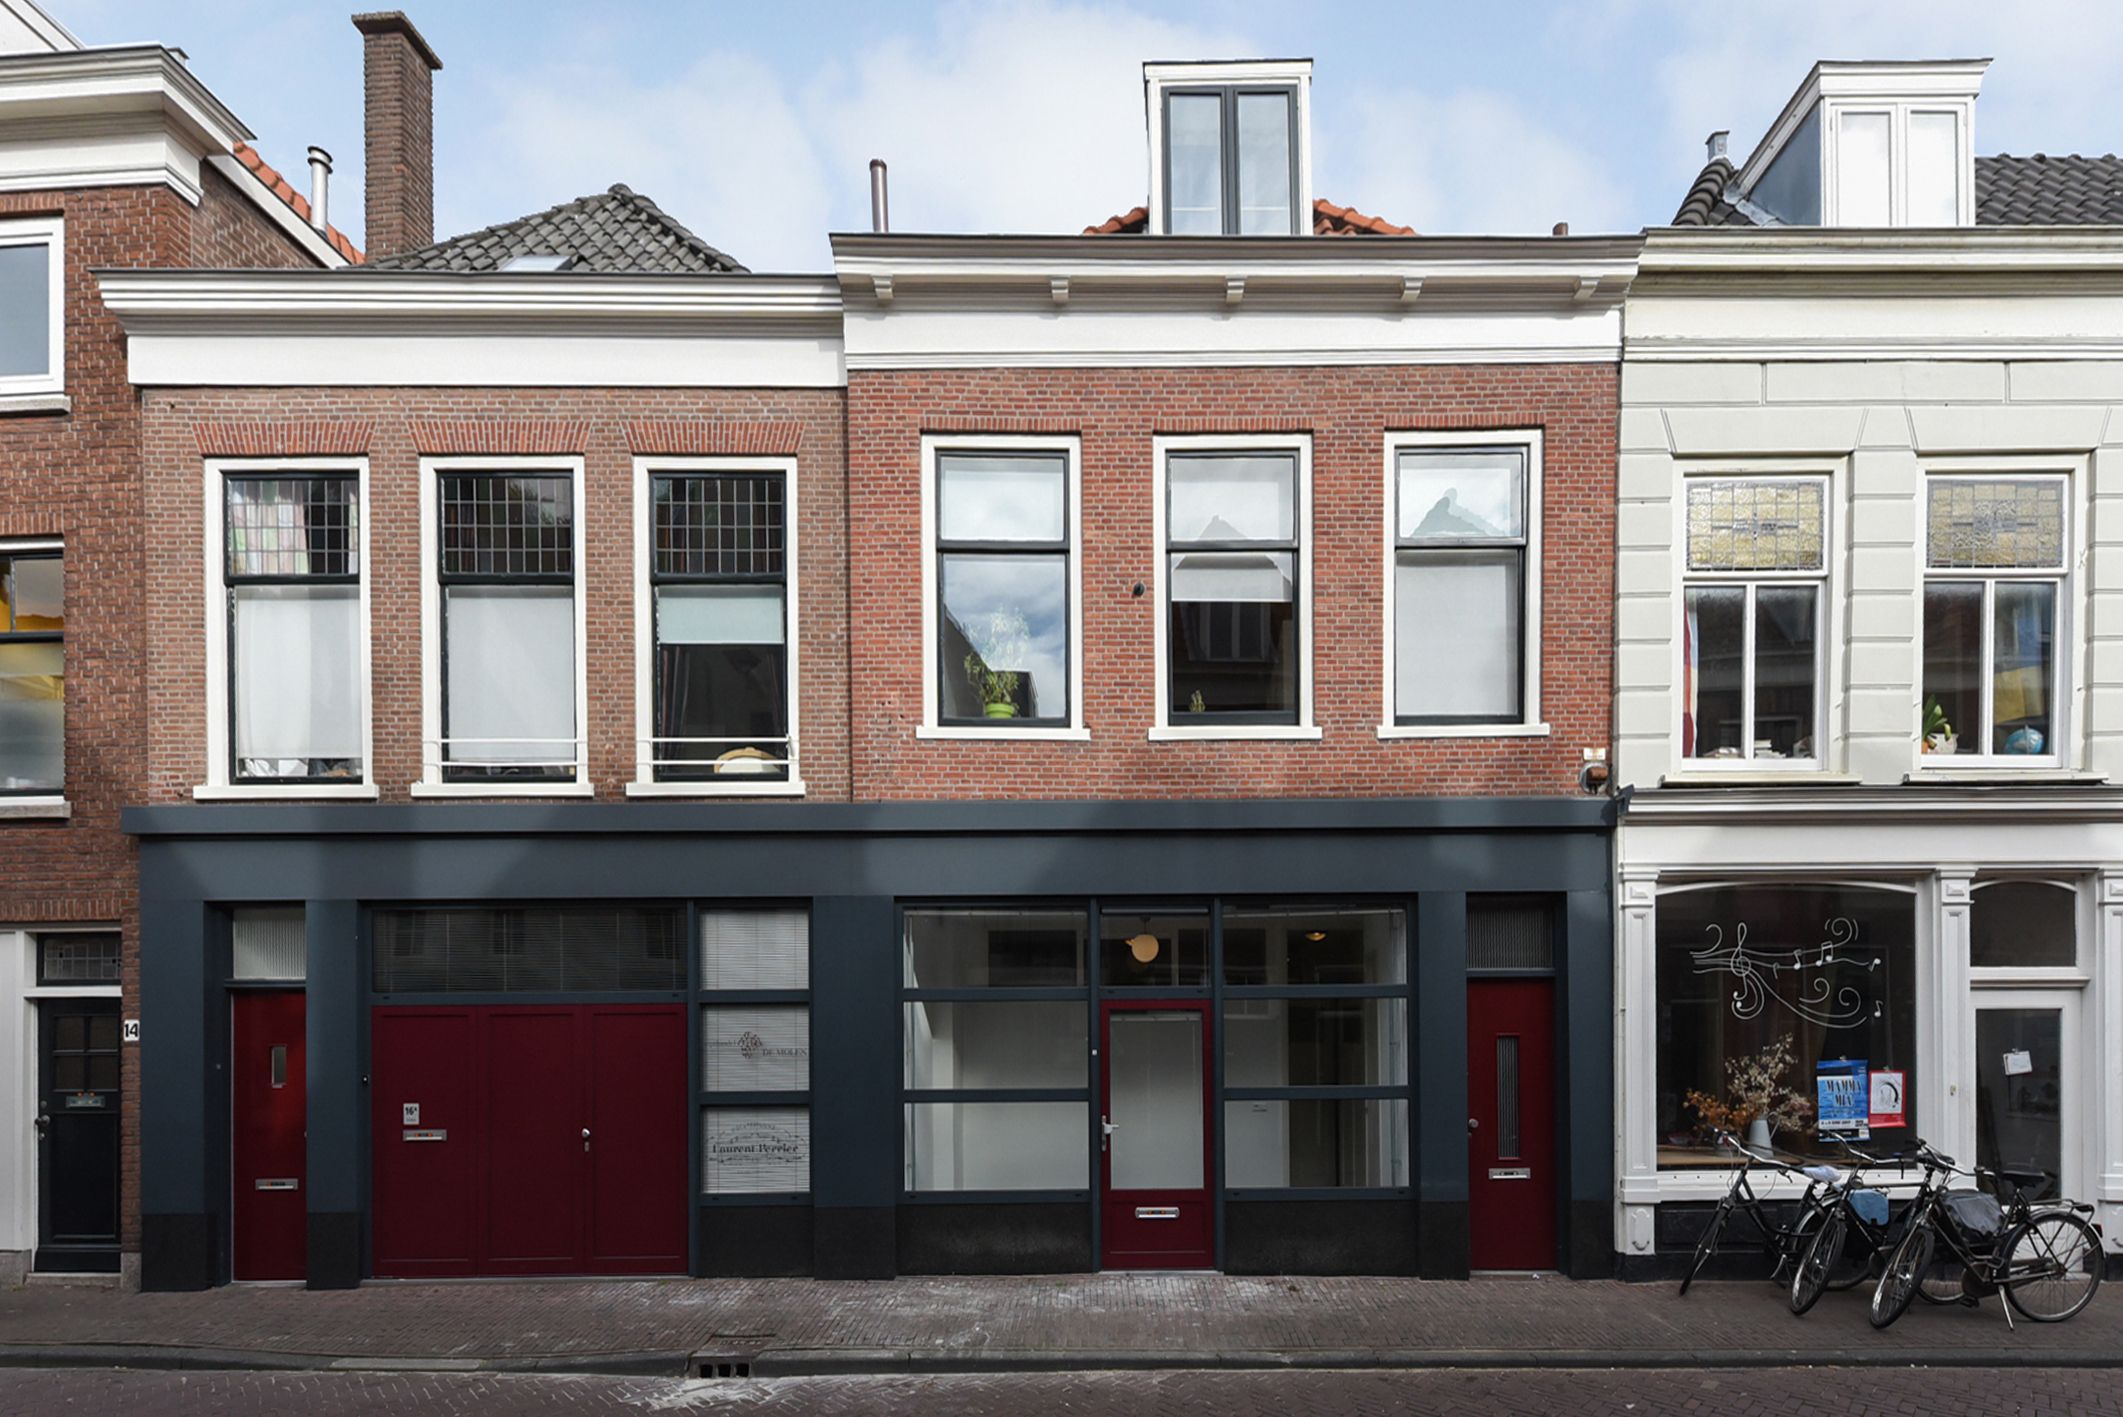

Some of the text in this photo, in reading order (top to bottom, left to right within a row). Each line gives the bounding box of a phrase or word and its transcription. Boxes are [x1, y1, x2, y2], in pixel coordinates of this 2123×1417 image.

[124, 1023, 138, 1037] 14
[776, 1048, 808, 1056] MOLEN
[1826, 1080, 1862, 1092] MAMMA
